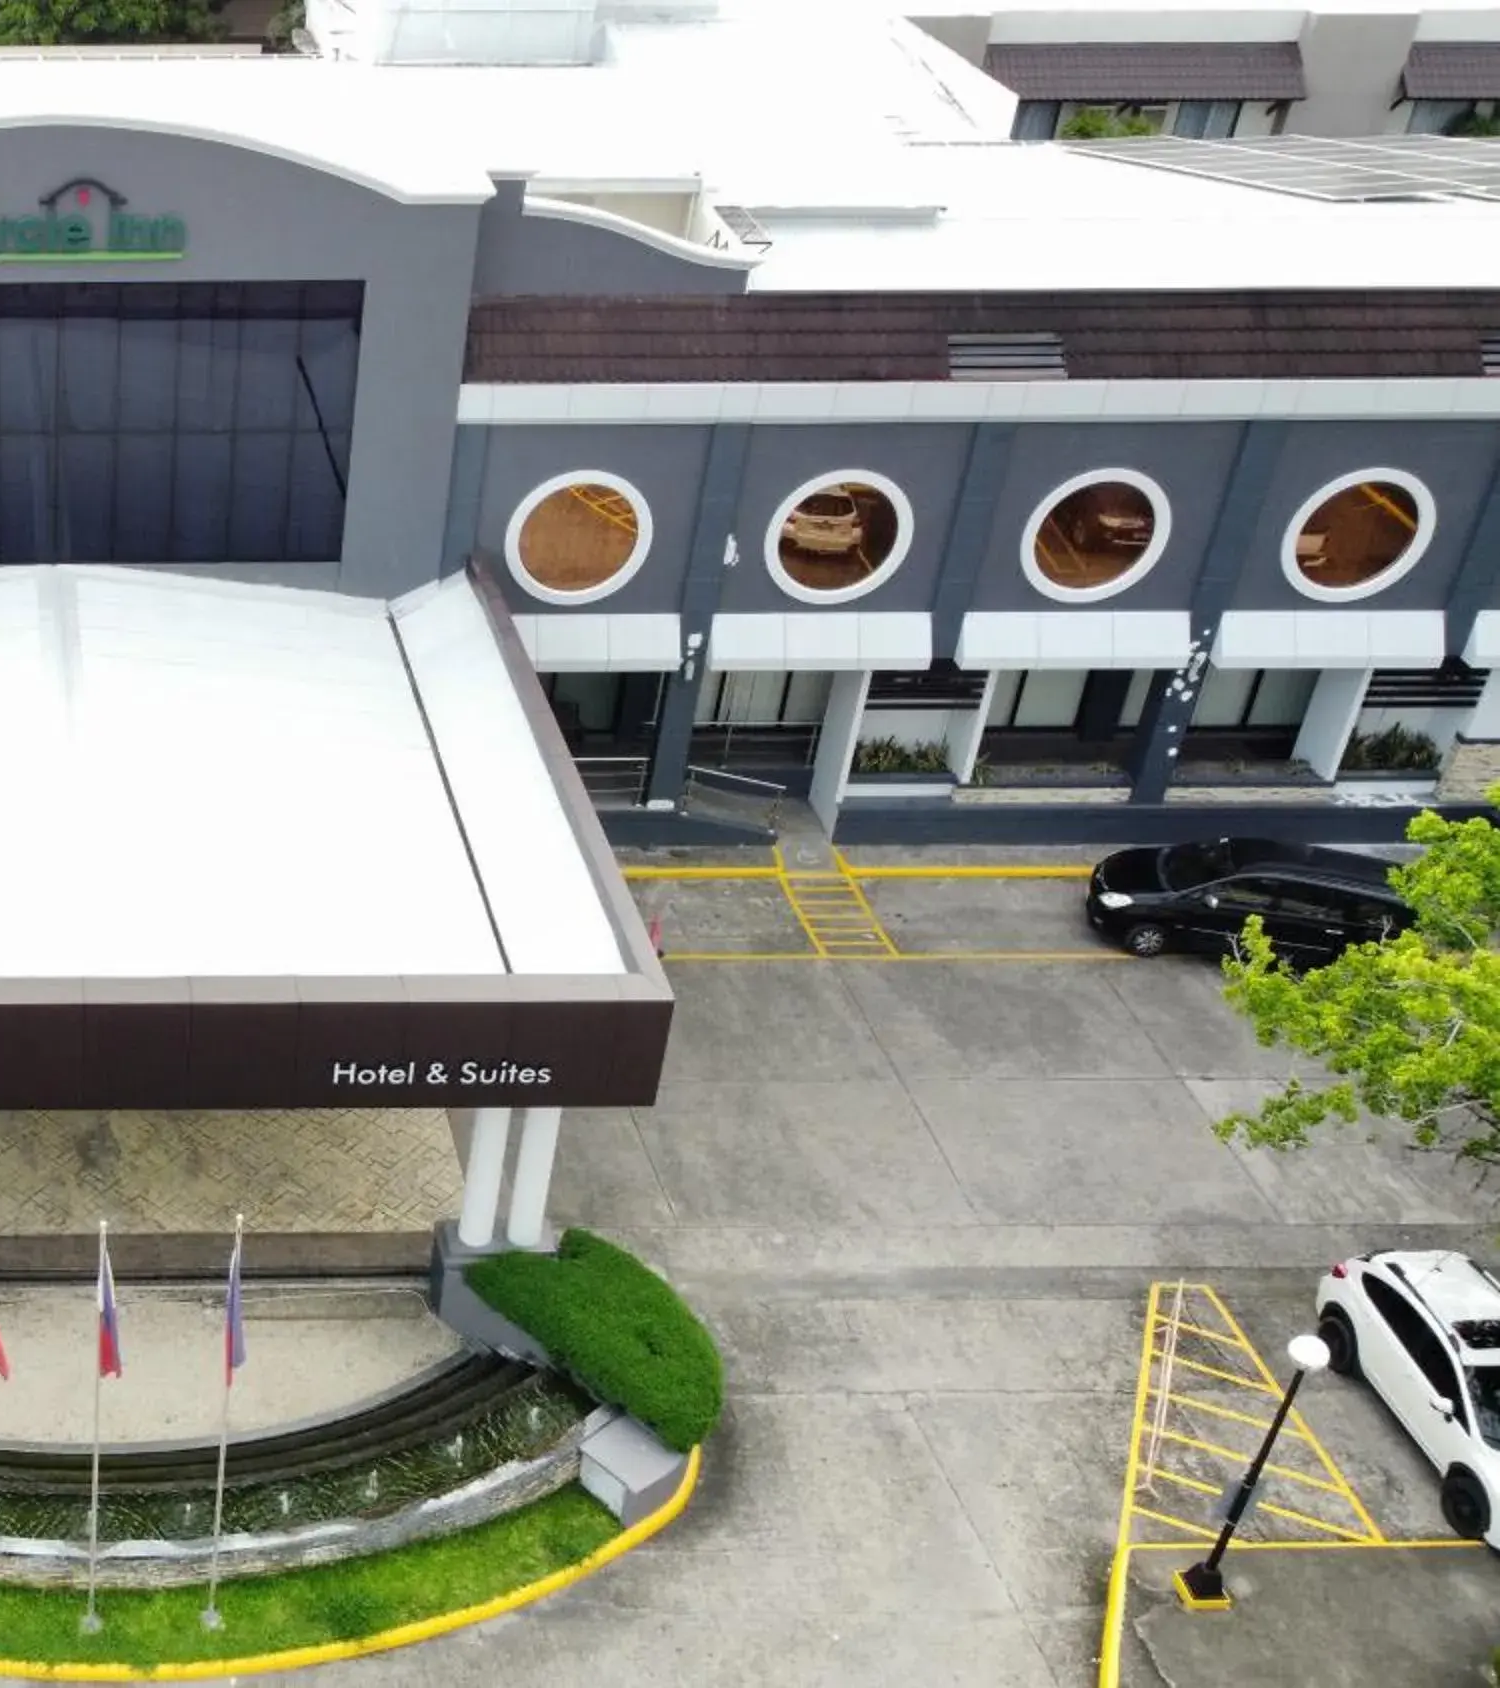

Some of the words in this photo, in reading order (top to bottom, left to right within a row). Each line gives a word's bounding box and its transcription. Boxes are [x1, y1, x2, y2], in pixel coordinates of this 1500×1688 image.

[107, 213, 187, 252] Inn
[332, 1061, 415, 1085] Hotel
[426, 1062, 449, 1085] &
[459, 1061, 552, 1085] Suites
